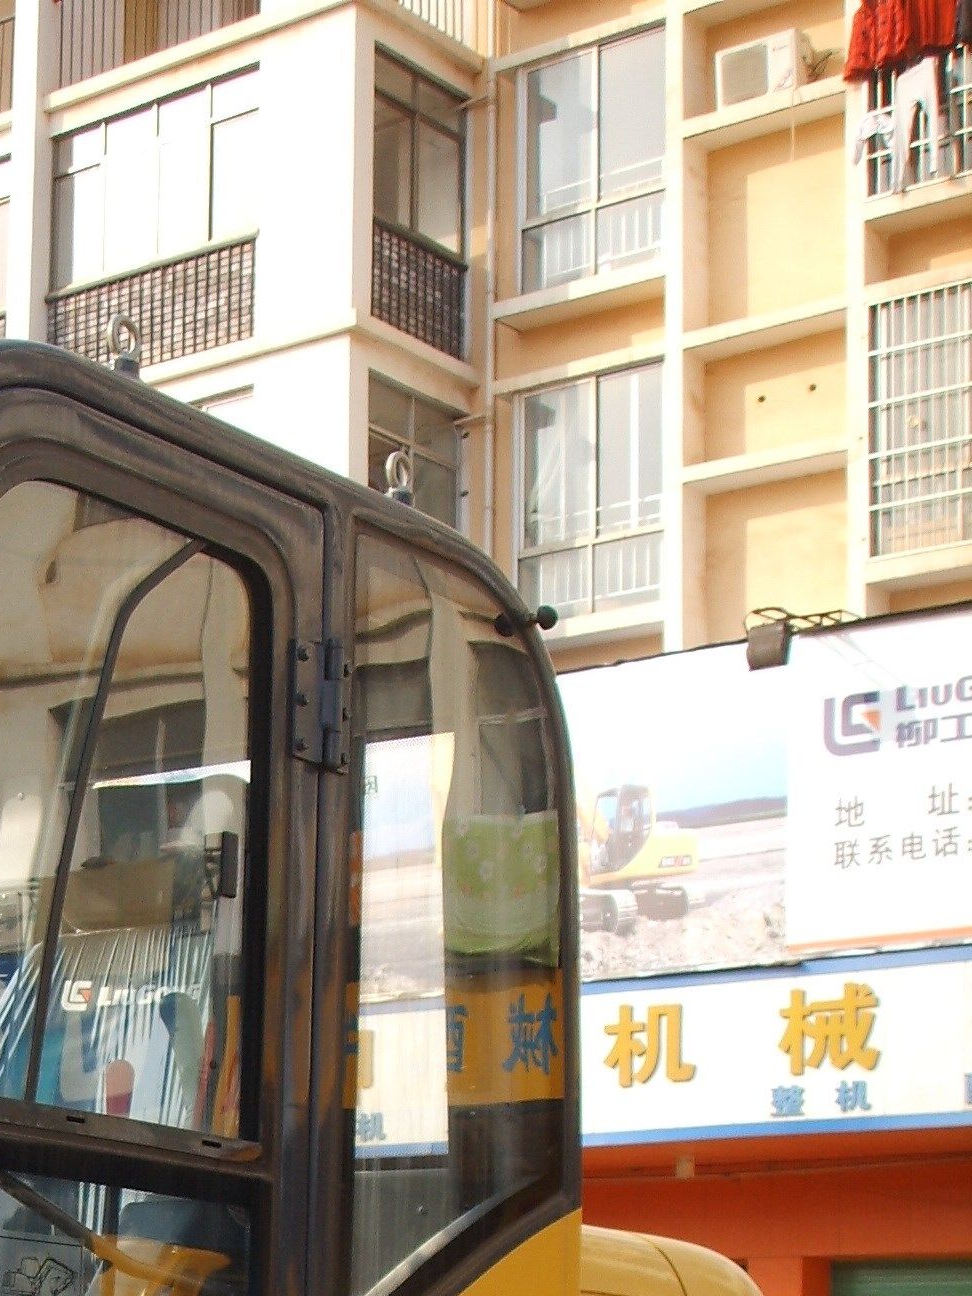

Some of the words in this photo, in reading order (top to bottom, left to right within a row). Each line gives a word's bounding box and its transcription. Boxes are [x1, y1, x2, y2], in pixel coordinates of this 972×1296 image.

[896, 712, 972, 749] 柳工
[604, 982, 881, 1088] 机械
[771, 1080, 873, 1118] 整机
